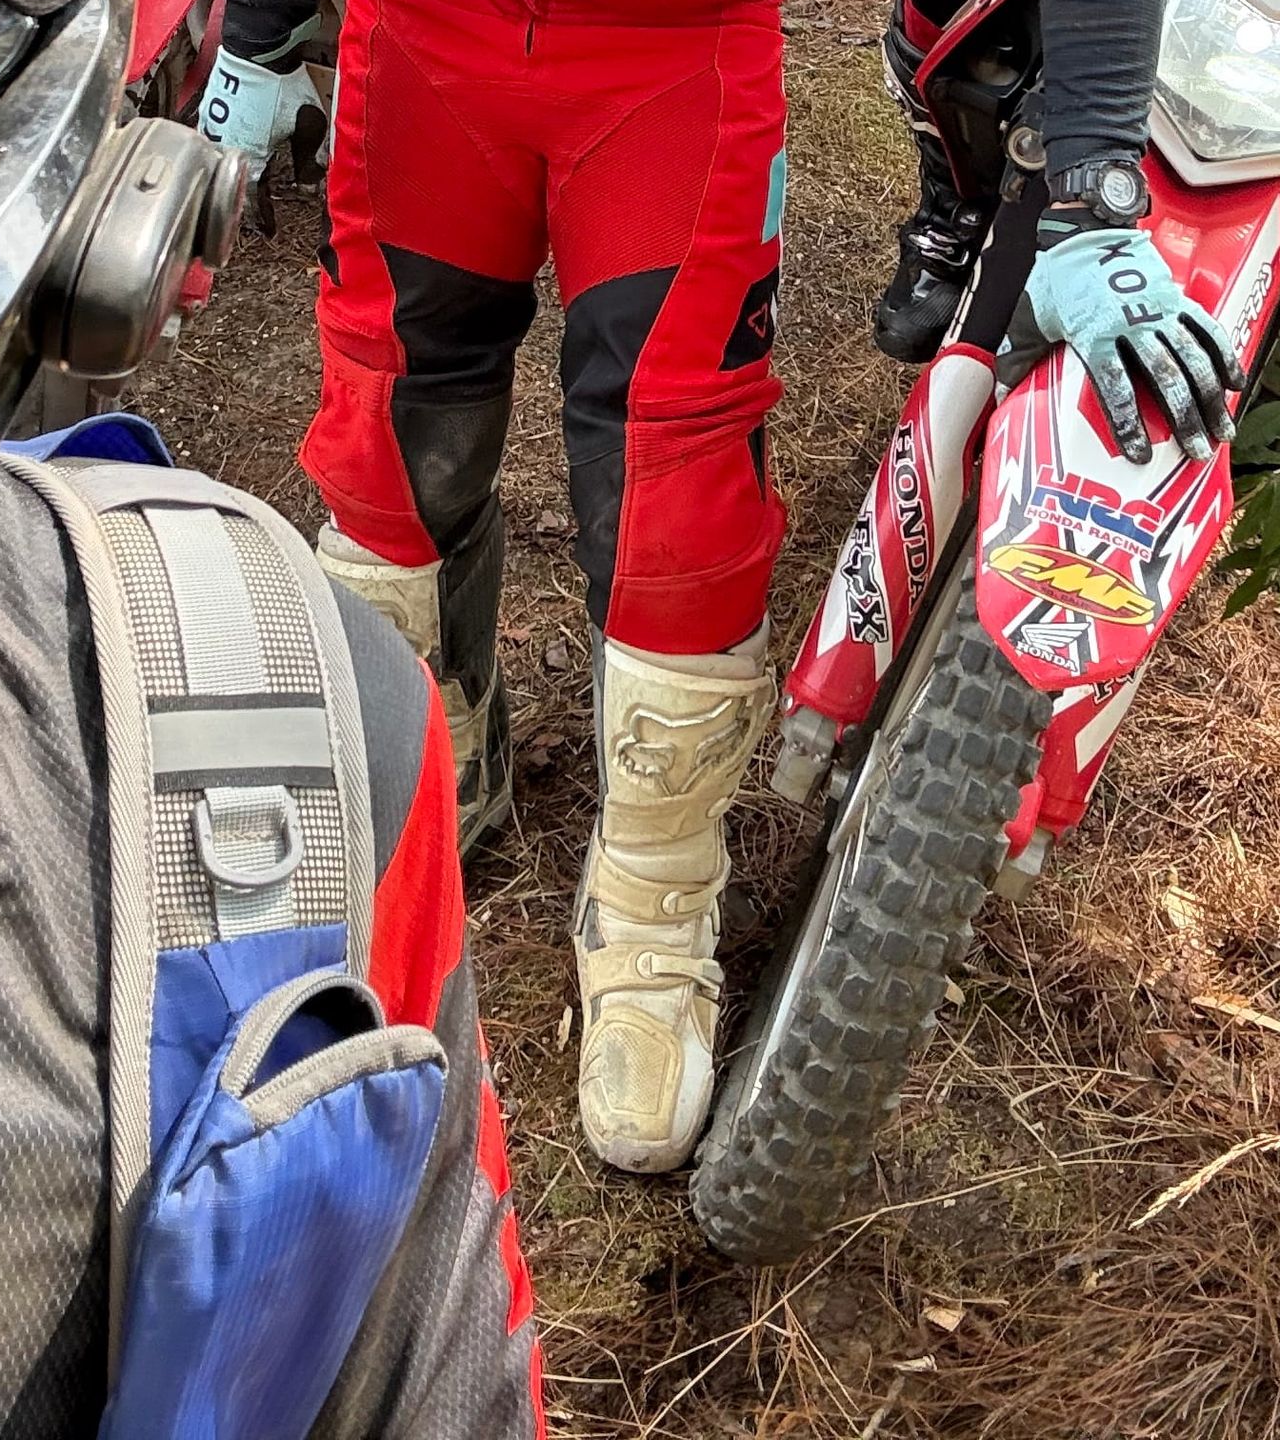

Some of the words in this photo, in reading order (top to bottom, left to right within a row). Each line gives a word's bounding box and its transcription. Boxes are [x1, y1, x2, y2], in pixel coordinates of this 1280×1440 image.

[1098, 239, 1163, 327] FOX
[894, 420, 929, 615] HONDA
[1026, 508, 1084, 533] HONDA
[1088, 527, 1151, 561] RACING
[1032, 466, 1164, 549] HRC
[989, 546, 1156, 616] FMF
[1015, 640, 1079, 672] HONDA
